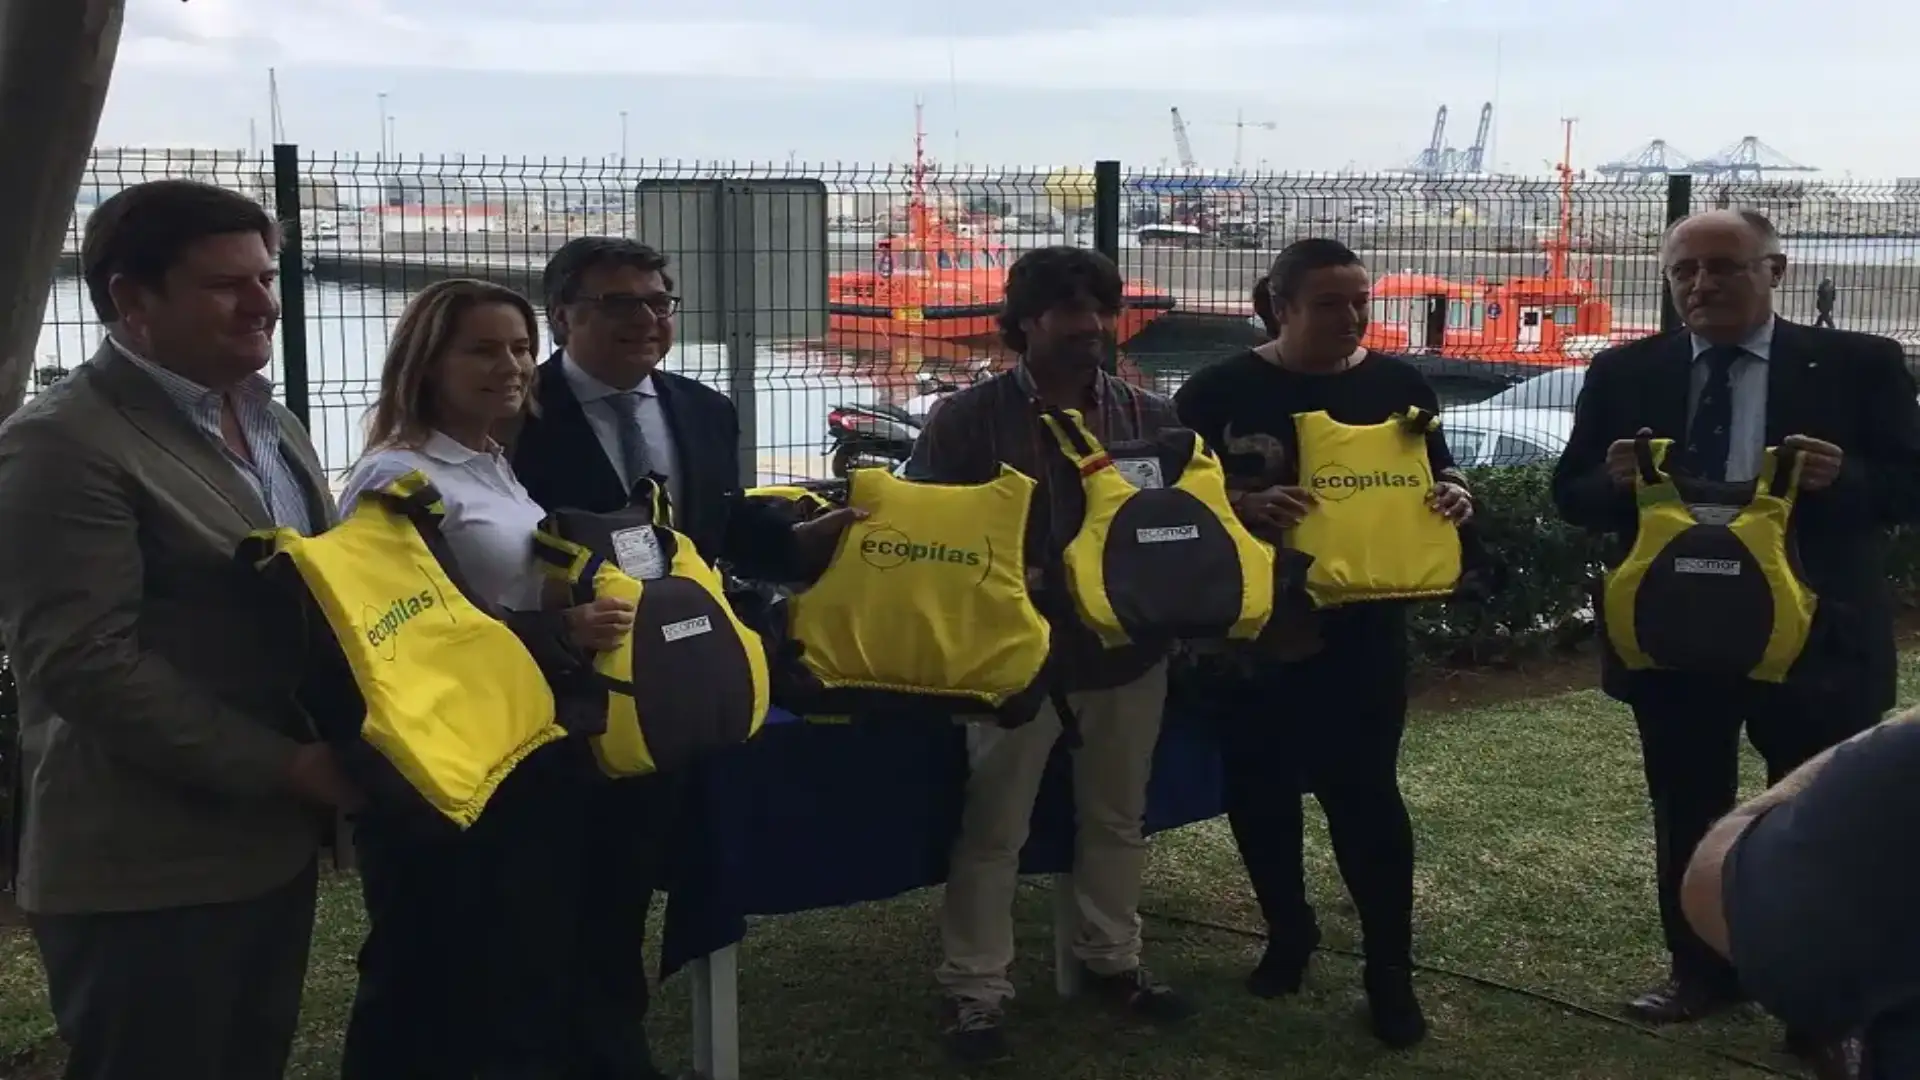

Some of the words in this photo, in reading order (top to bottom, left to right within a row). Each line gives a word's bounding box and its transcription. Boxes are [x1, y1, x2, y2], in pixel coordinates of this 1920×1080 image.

[1312, 471, 1420, 491] ecopilas
[861, 538, 981, 566] ecopilas
[366, 589, 434, 647] ecopilas
